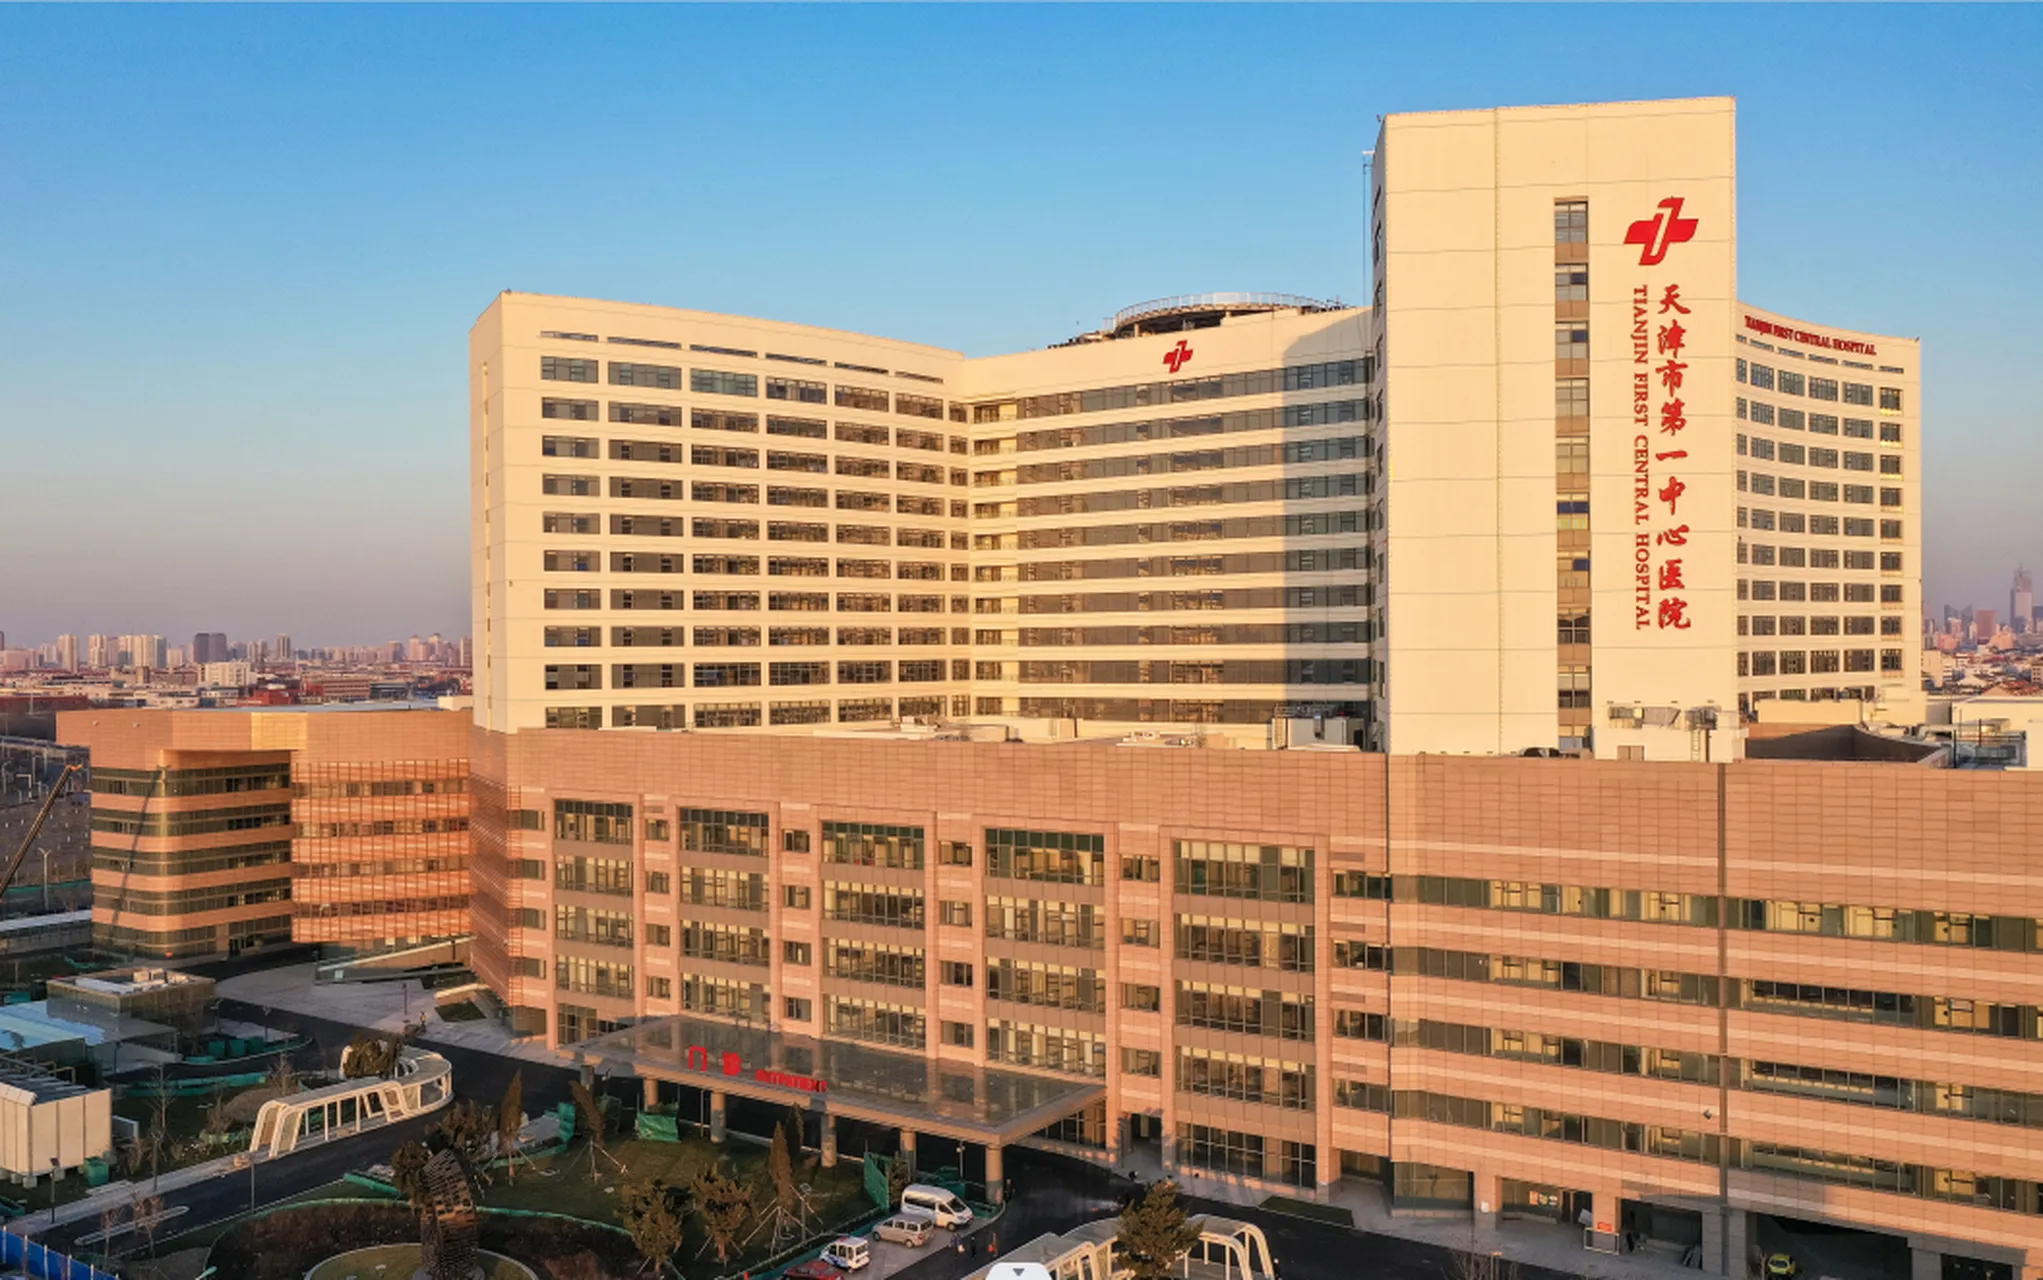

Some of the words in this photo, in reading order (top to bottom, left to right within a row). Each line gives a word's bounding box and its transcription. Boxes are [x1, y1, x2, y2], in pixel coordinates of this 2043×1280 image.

[1631, 285, 1648, 364] TIANJIN
[1774, 324, 1793, 341] FIRST
[1795, 330, 1831, 348] CENTRAL
[1832, 338, 1876, 355] HOSPITAL
[1634, 372, 1649, 426] FIRST
[1634, 435, 1649, 525] CENTRAL
[1656, 284, 1691, 629] 天津市第一中心医院
[1635, 533, 1650, 630] HOSPITAL
